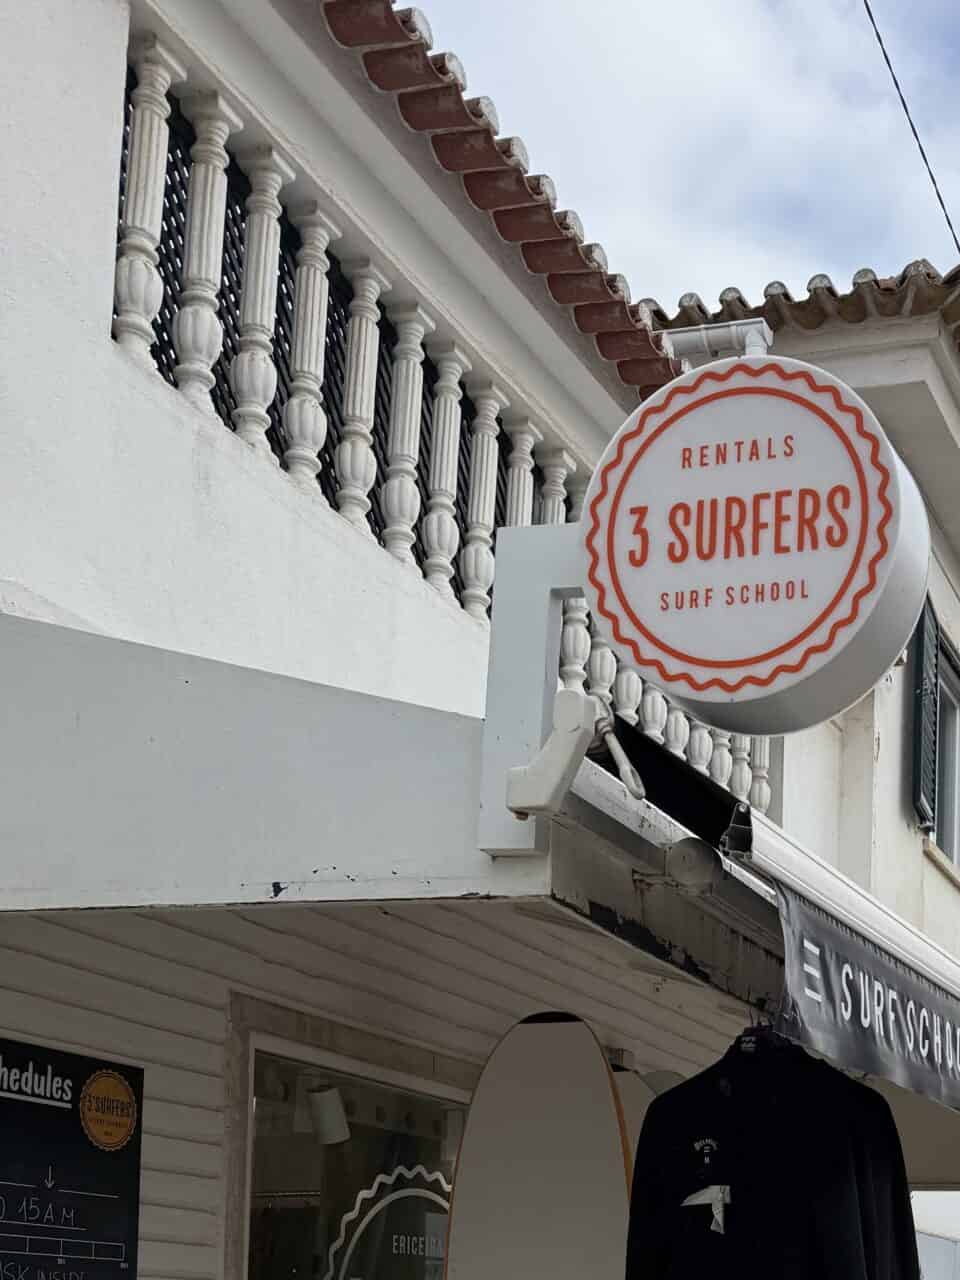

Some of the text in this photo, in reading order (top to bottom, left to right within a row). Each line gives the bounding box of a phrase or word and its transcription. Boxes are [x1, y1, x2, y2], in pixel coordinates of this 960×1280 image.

[681, 435, 795, 469] RENTALS
[628, 484, 851, 568] 3 SURFERS
[660, 579, 809, 612] SURF SCHOOL
[841, 963, 898, 1041] SURF
